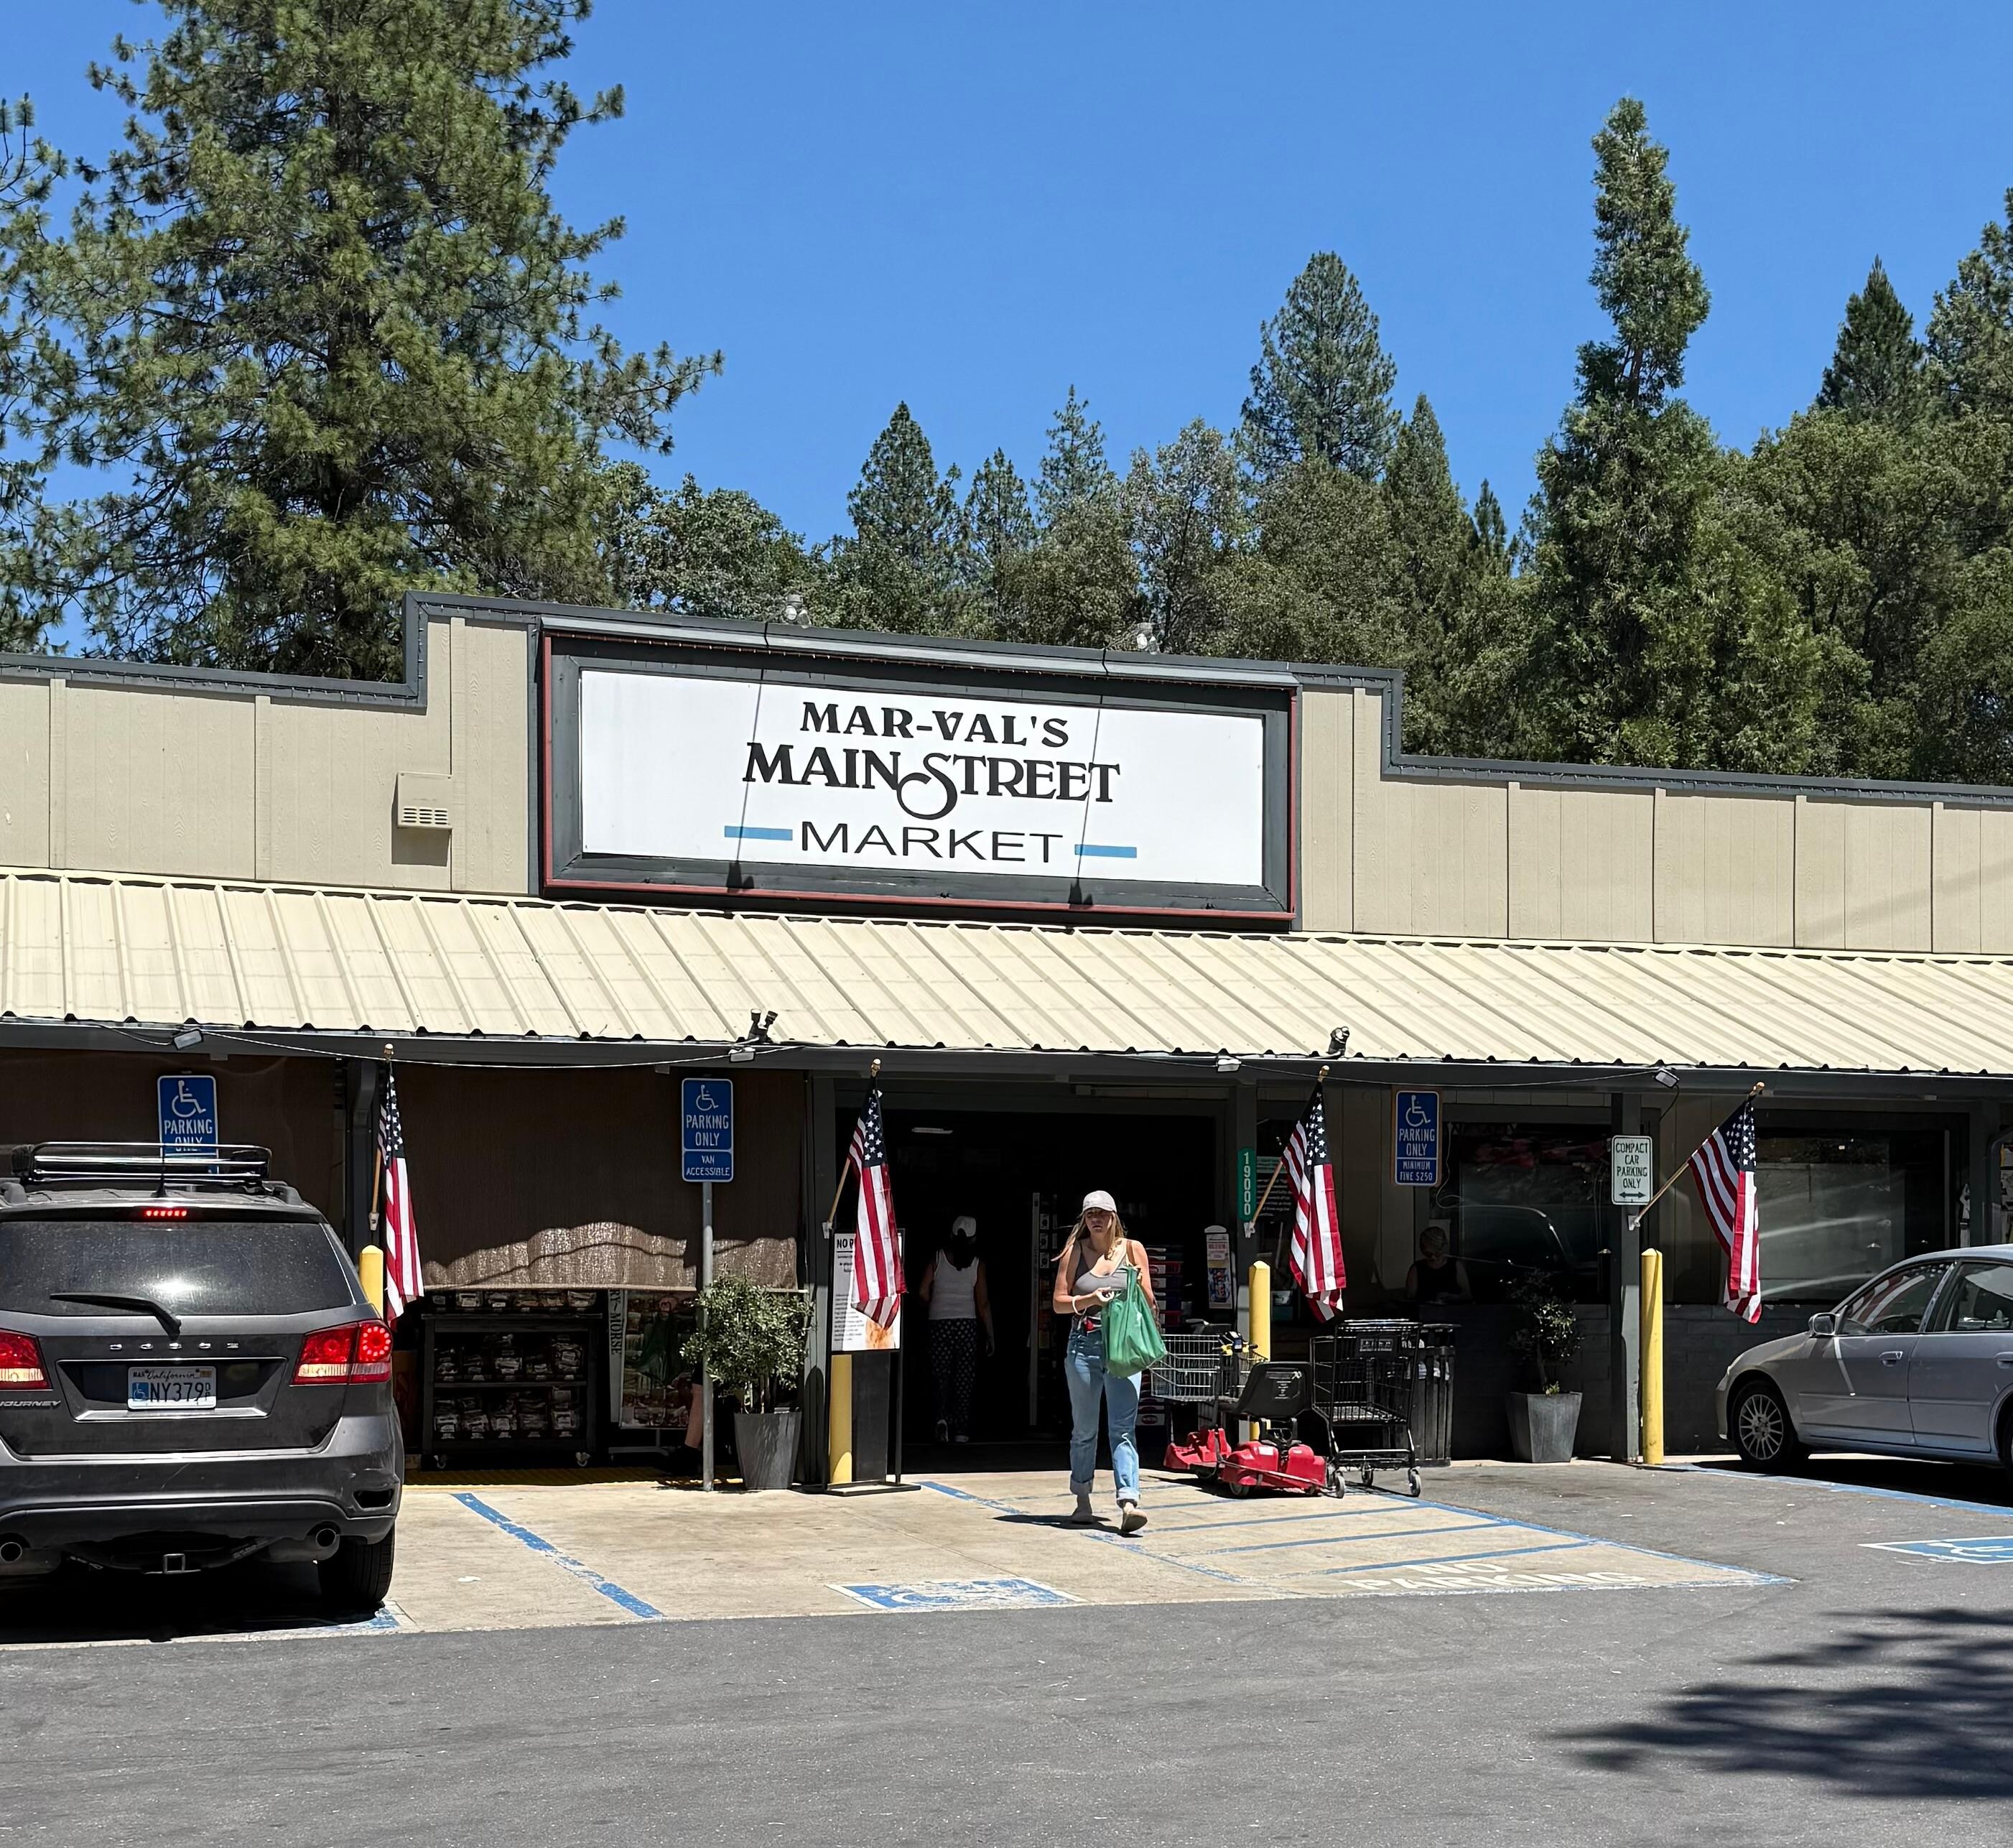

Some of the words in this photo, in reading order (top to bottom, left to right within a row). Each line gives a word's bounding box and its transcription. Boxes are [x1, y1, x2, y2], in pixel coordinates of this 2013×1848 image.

[800, 702, 1069, 748] MAR-VAL'S
[801, 822, 1064, 863] MARKET
[164, 1119, 213, 1135] PARKING
[686, 1115, 729, 1129] PARKING
[695, 1132, 720, 1146] ONLY
[1399, 1128, 1435, 1141] PARKING
[1406, 1143, 1427, 1156] ONLY
[1616, 1143, 1648, 1153] COMPACT
[702, 1155, 715, 1164] VAN
[1403, 1161, 1431, 1170] MINIMUM
[1624, 1154, 1640, 1165] CAR
[686, 1167, 730, 1176] ACCESSIBLE
[1617, 1166, 1648, 1176] PARKING
[1623, 1178, 1641, 1189] ONLY
[837, 1239, 848, 1249] NO
[147, 1368, 202, 1382] California
[150, 1382, 203, 1402] NY379
[1405, 1563, 1510, 1574] NO
[1339, 1571, 1646, 1589] PARKING
